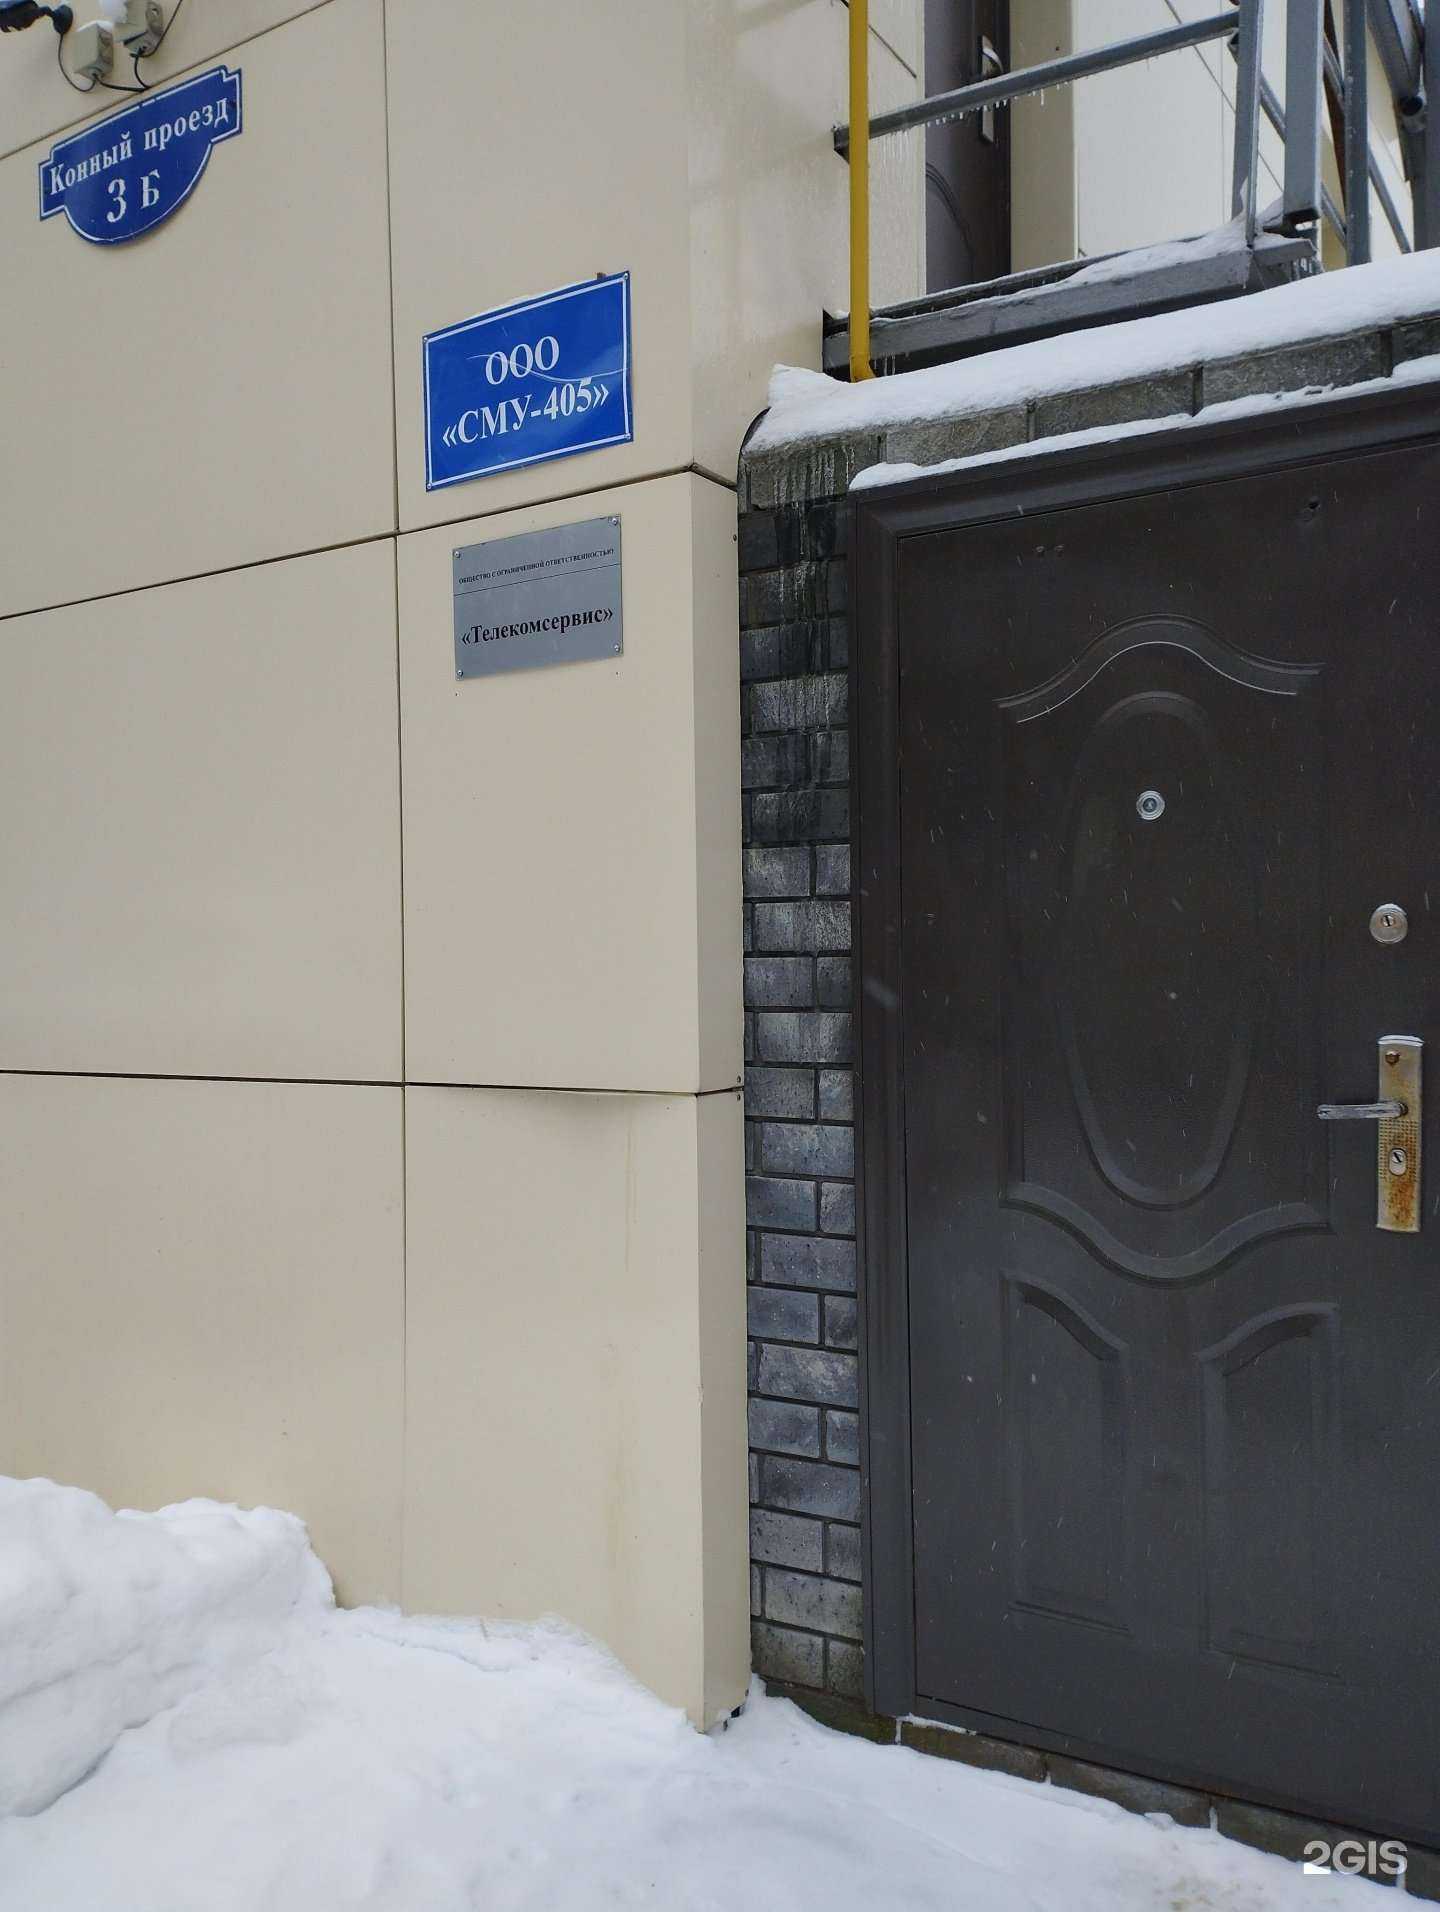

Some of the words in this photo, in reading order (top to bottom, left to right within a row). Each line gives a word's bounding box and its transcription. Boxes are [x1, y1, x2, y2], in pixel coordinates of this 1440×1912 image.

[50, 131, 133, 195] Конный
[143, 98, 229, 151] проезд
[106, 178, 127, 223] 3
[139, 169, 161, 209] Б
[485, 336, 560, 385] ООО
[442, 377, 610, 448] «СМУ-405»
[458, 572, 491, 585] ОБЩЕСТВО
[496, 561, 545, 577] ОГРАНИЧЕННОЙ
[545, 548, 614, 567] ОТВЕТСТВЕННОСТЬЮ
[461, 607, 613, 645] «Телекомсервис»
